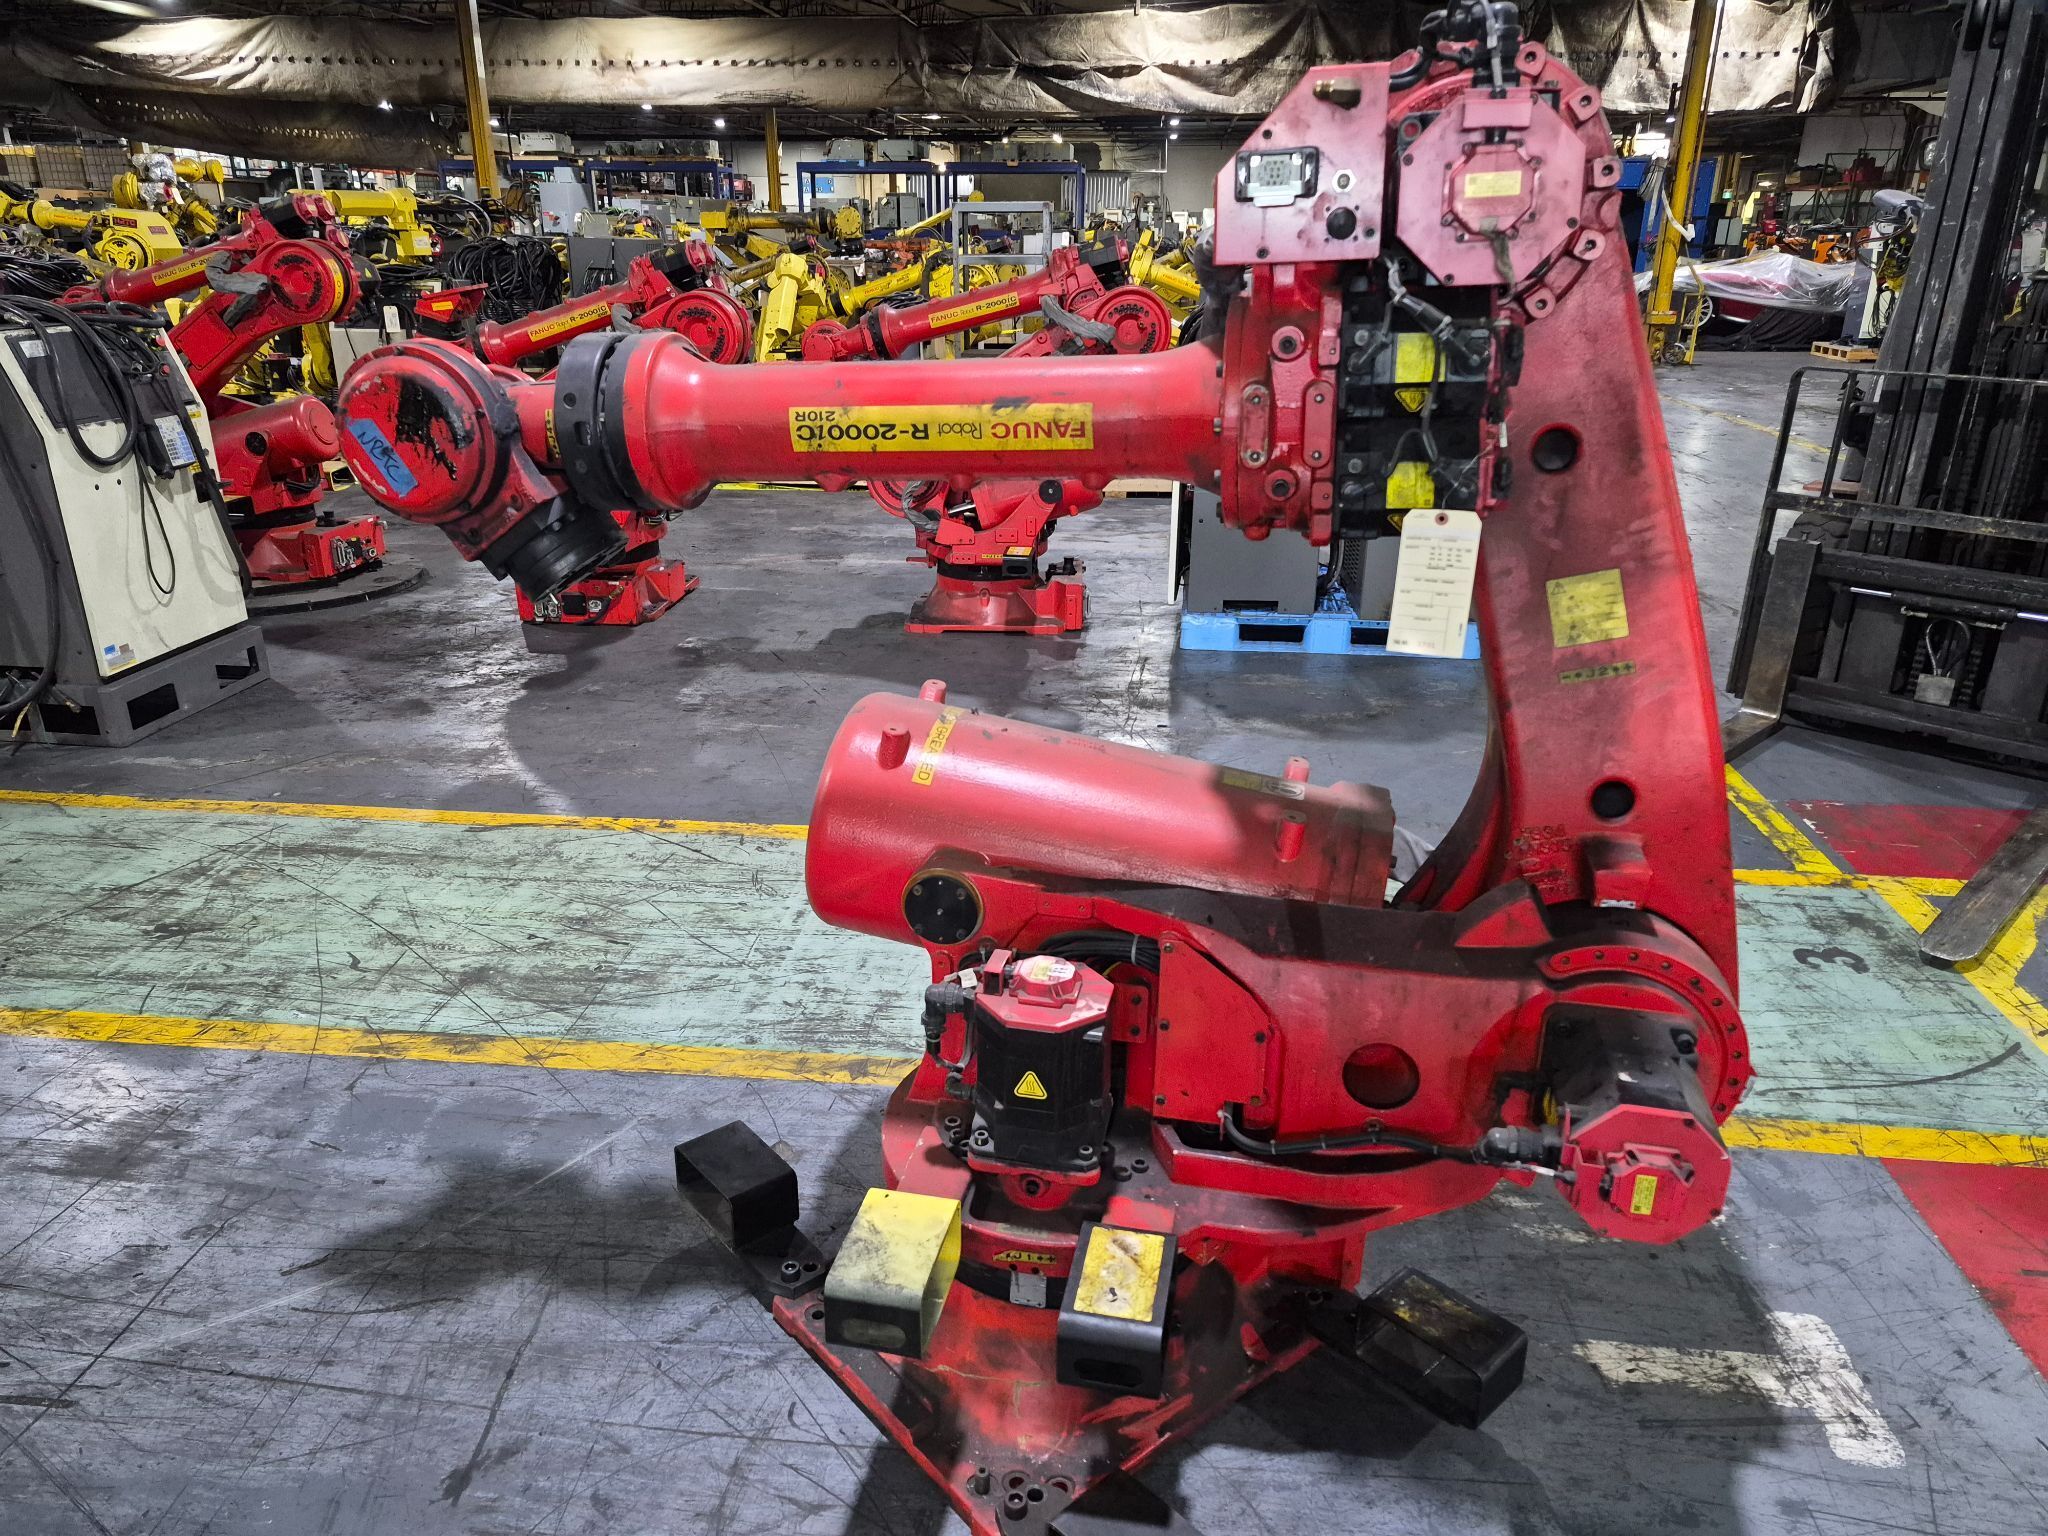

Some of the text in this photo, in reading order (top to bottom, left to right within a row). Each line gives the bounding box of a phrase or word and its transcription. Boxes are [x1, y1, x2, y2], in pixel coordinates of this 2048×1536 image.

[154, 268, 177, 282] FANUC
[931, 311, 959, 324] FANUC
[530, 325, 555, 337] FANUC
[795, 410, 835, 422] 210R
[795, 421, 1087, 448] FANUC Robot R-2000iC
[918, 726, 948, 781] GREAED
